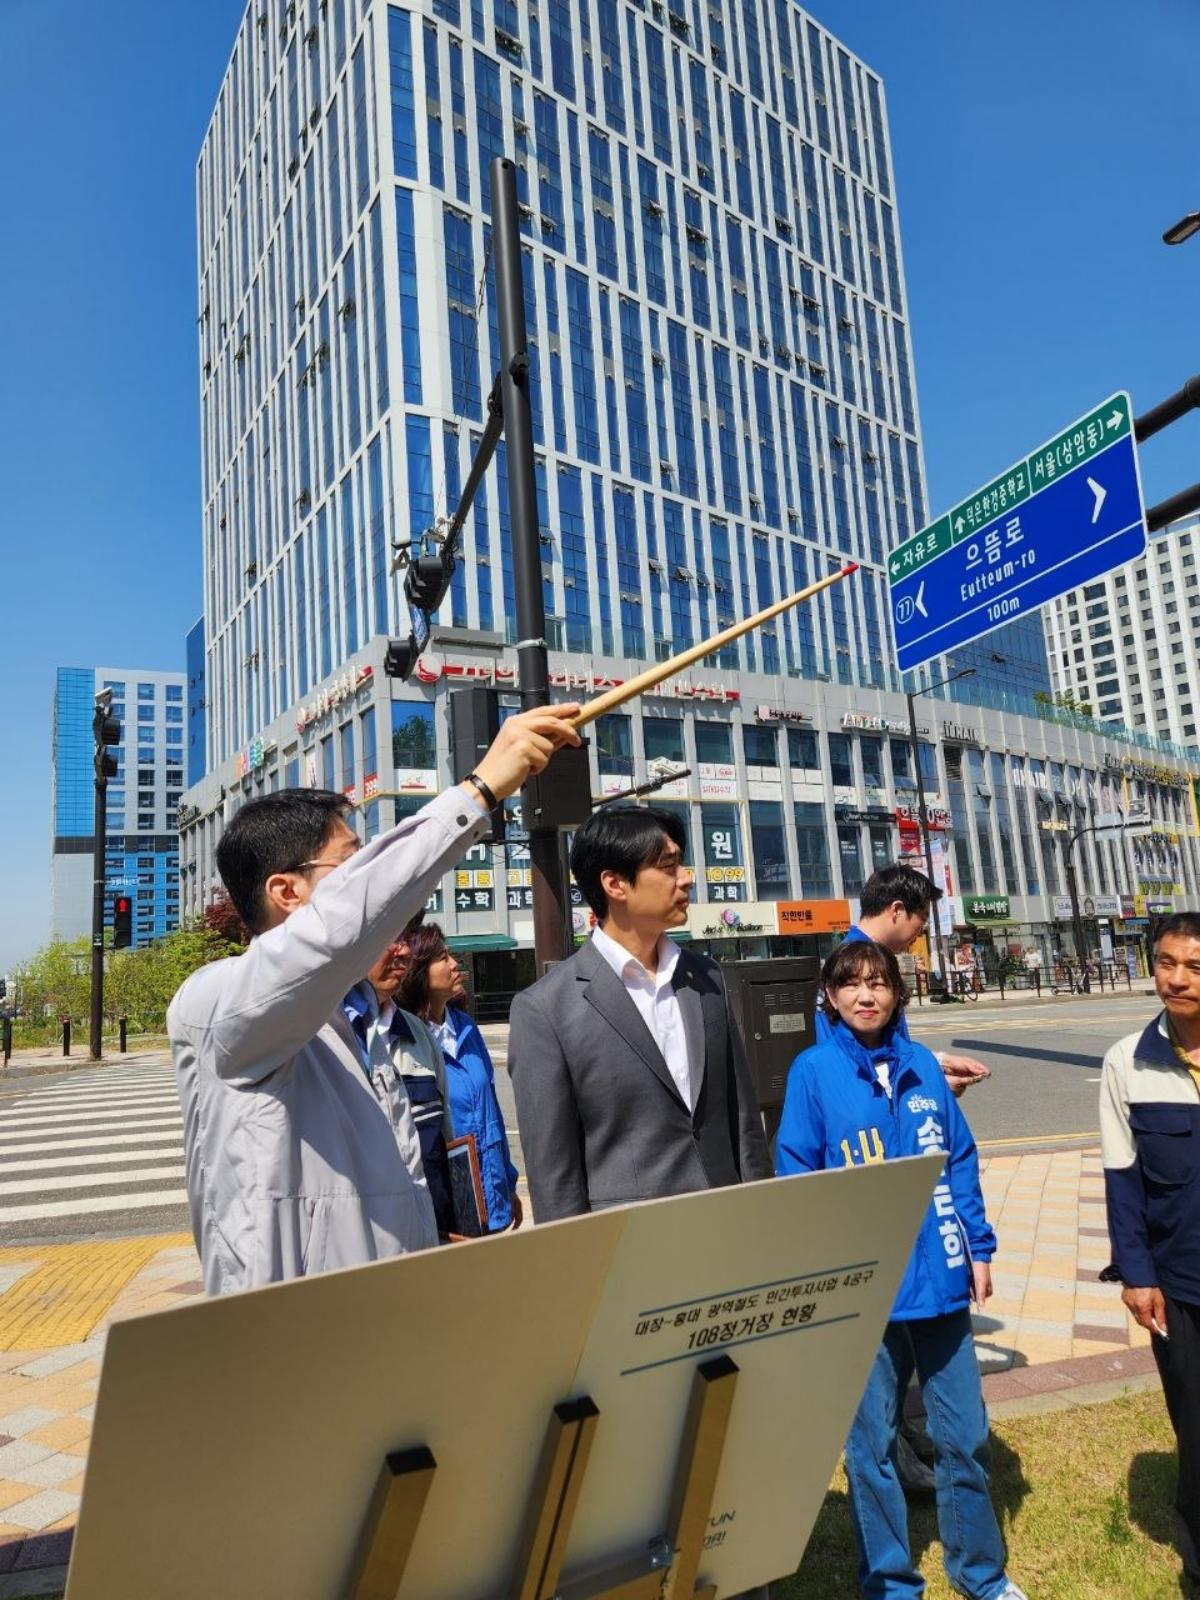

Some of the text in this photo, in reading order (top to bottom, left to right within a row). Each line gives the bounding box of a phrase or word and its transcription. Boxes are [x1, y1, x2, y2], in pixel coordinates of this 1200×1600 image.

[1034, 418, 1105, 478] 서울(상암동)
[903, 532, 938, 567] 자유로
[966, 516, 1024, 571] 으뜸로
[960, 549, 1036, 602] Eutteum-ro
[987, 596, 1020, 622] 100m
[456, 890, 489, 909] 수학
[713, 886, 737, 900] 과학
[707, 1294, 760, 1319] 광역철도
[766, 1277, 838, 1304] 민간투자사업
[842, 1270, 874, 1287] 4공구
[687, 1302, 817, 1350] 108정거장 현황
